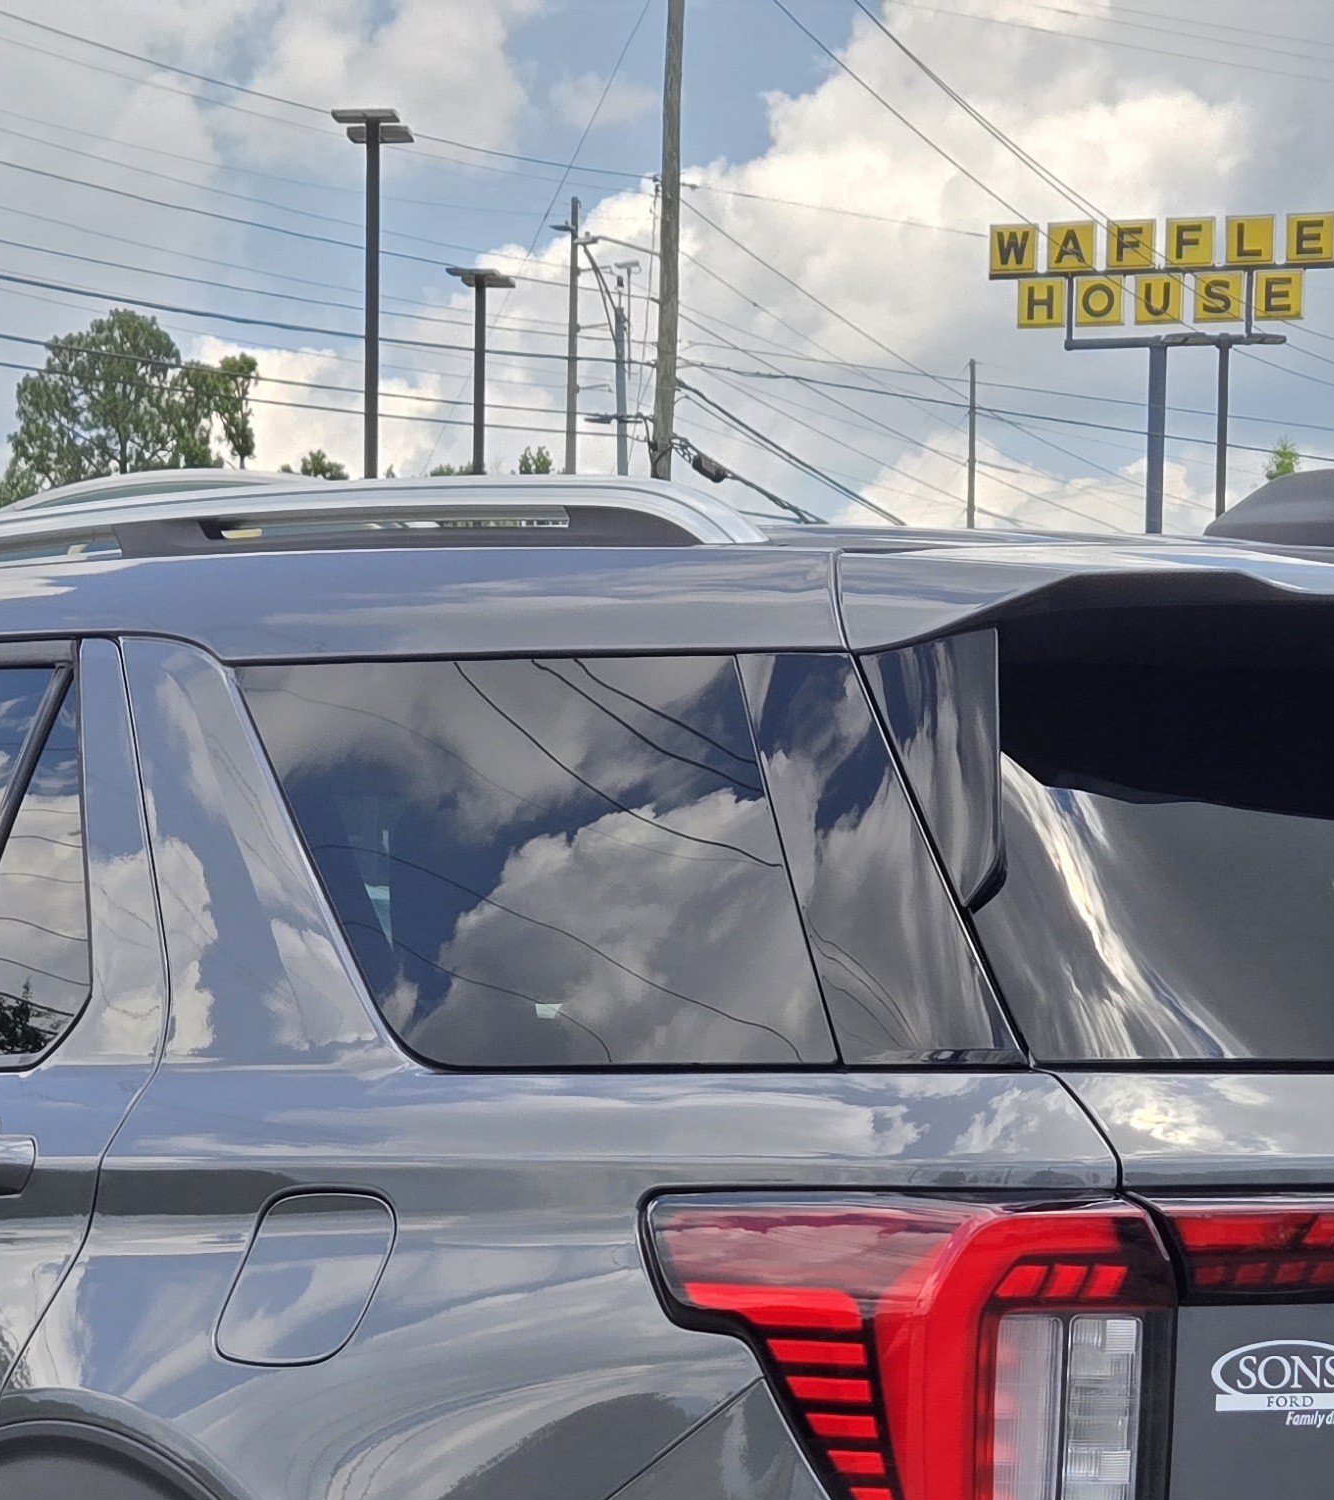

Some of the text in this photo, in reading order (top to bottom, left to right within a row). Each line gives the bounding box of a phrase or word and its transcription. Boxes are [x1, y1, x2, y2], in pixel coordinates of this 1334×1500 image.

[996, 219, 1324, 265] WAFFLE
[1026, 277, 1292, 320] HOUSE
[1266, 1395, 1314, 1407] FORD
[1285, 1411, 1325, 1428] Family
